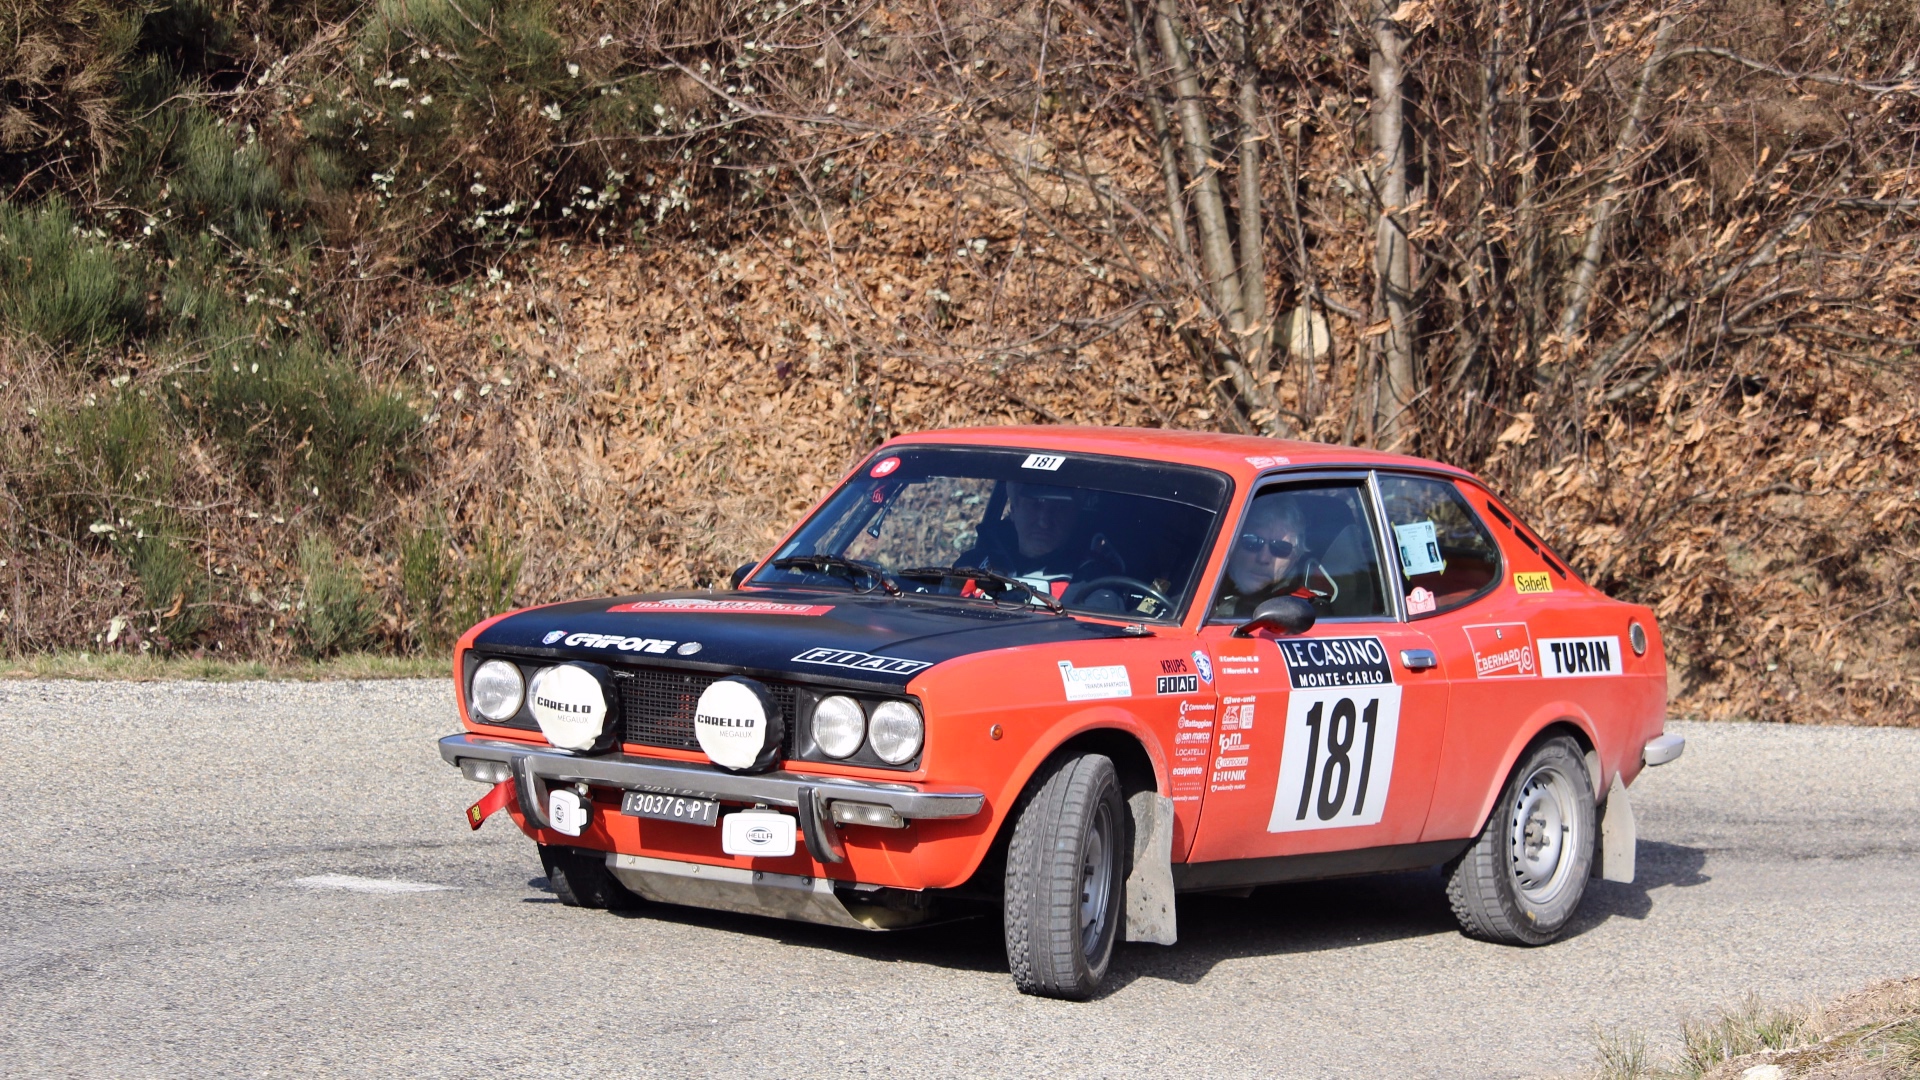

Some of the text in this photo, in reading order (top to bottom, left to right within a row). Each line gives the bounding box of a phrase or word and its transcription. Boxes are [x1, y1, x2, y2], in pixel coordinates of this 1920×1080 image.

[1032, 456, 1058, 468] 181
[1517, 575, 1550, 592] Sabelt
[564, 632, 677, 654] GRIFONE
[804, 650, 920, 672] FIAT
[1282, 639, 1383, 667] LE CASINO
[1550, 641, 1611, 675] TURIN
[1160, 659, 1188, 673] KRUPS
[1475, 650, 1521, 673] EBERHARD
[1073, 667, 1109, 682] BORGO
[1109, 666, 1127, 679] PIO
[1159, 677, 1197, 693] FIAT
[537, 697, 592, 714] CARELLO
[1188, 703, 1216, 711] Commodore
[558, 714, 589, 724] MEGALUX
[697, 714, 755, 728] CARELLO
[719, 730, 752, 738] MEGALUX
[1191, 732, 1210, 741] marco
[1218, 733, 1242, 754] rpm
[1175, 748, 1207, 756] LOCATELLI
[1295, 697, 1380, 822] 181
[626, 793, 713, 821] 130376 PT
[748, 832, 773, 840] HELLA
